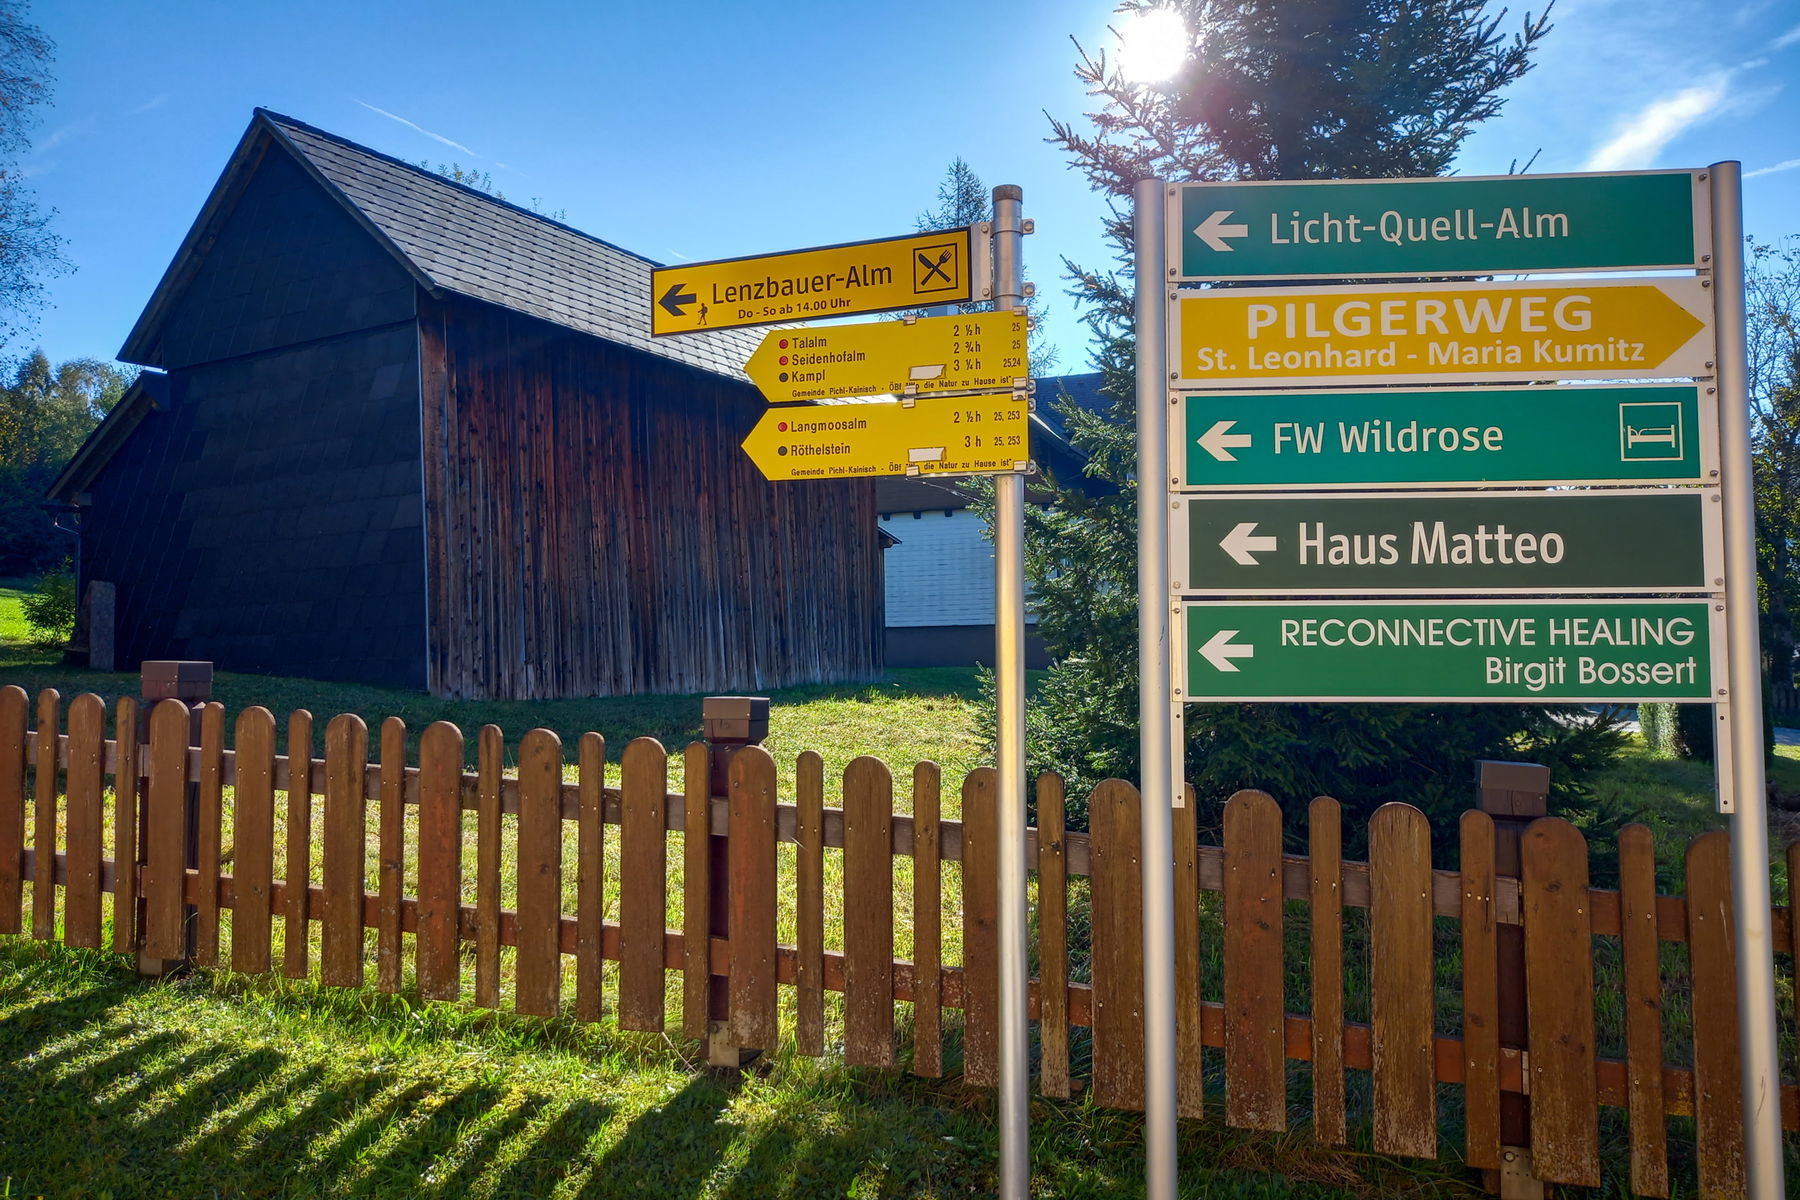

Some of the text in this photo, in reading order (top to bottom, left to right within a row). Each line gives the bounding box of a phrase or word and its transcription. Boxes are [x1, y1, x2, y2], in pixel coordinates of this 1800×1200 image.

[1270, 207, 1570, 246] Licht-Quell-Alm
[712, 264, 892, 305] Lenzbauer-Alm
[738, 308, 753, 319] Do
[763, 307, 777, 317] So
[780, 303, 793, 314] ab
[797, 300, 827, 313] 14.00
[830, 297, 851, 308] Uhr
[1246, 295, 1593, 340] PILGERWEG
[792, 336, 827, 349] Talalm
[953, 325, 960, 337] 2
[975, 323, 981, 335] h
[1012, 322, 1020, 332] 25
[791, 350, 866, 366] Seidenhofalm
[953, 342, 960, 354] 2
[975, 341, 981, 353] h
[1012, 340, 1021, 350] 25
[1197, 346, 1237, 372] St.
[1247, 341, 1396, 371] Leonhard
[1428, 339, 1522, 367] Maria
[1534, 337, 1646, 364] Kumitz
[791, 369, 826, 383] Kampl
[953, 359, 960, 371] 3
[975, 358, 981, 370] h
[792, 388, 826, 398] Gemeinde
[923, 381, 934, 389] die
[938, 379, 957, 389] Natur
[961, 379, 970, 387] zu
[974, 377, 996, 386] Hause
[791, 418, 867, 434] Langmoosalm
[953, 411, 960, 424] 2
[975, 410, 981, 422] h
[1007, 410, 1020, 420] 253
[791, 442, 851, 456] Röthelstein
[964, 435, 971, 447] 3
[975, 435, 981, 447] h
[1007, 436, 1021, 445] 253
[1274, 419, 1504, 455] FW Wildrose
[791, 467, 825, 476] Gemeinde
[828, 464, 877, 474] Pichl-Kainisch
[923, 462, 935, 470] die
[938, 461, 958, 470] Natur
[974, 459, 996, 468] Hause
[1299, 521, 1565, 566] Haus Matteo
[1281, 617, 1696, 648] RECONNECTIVE HEALING
[1485, 656, 1697, 692] Birgit Bossert
